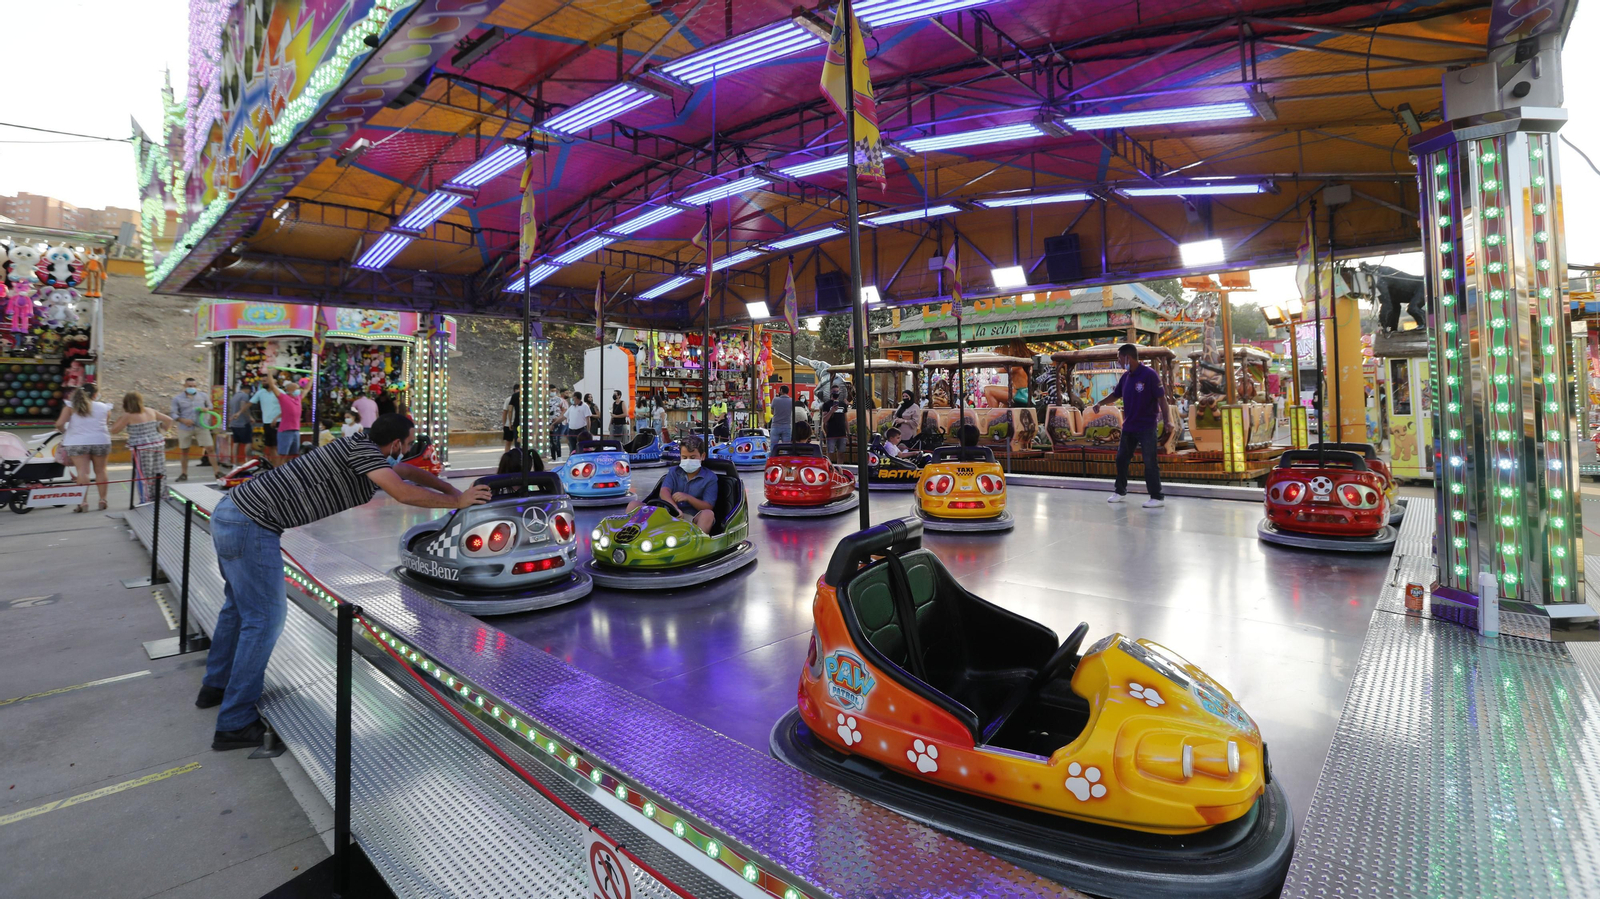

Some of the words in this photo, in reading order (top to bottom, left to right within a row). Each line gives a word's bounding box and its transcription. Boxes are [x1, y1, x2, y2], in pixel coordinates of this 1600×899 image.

[976, 324, 986, 336] la
[990, 322, 1017, 336] selva
[880, 457, 891, 465] 12
[878, 469, 923, 478] BATMA
[32, 492, 82, 500] ENTRADA
[402, 556, 459, 581] ercedes-Benz
[824, 655, 877, 697] PAW
[832, 686, 860, 706] PATROL
